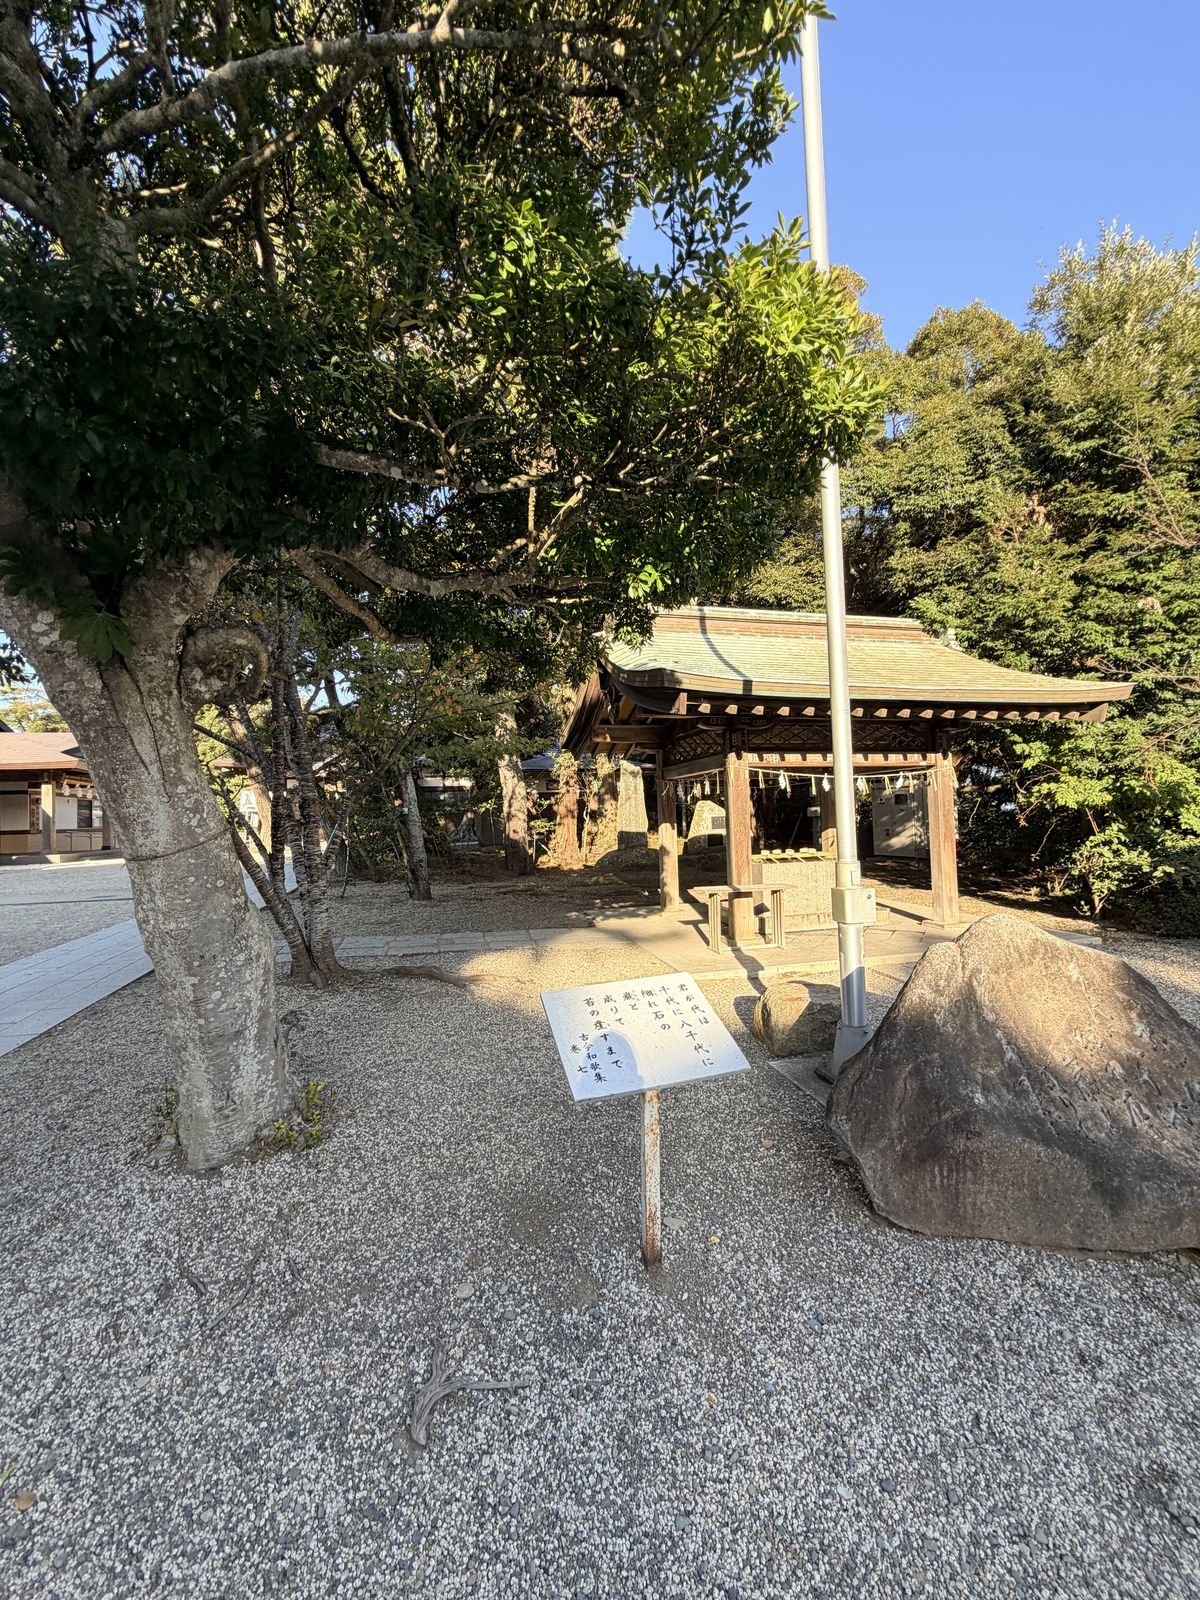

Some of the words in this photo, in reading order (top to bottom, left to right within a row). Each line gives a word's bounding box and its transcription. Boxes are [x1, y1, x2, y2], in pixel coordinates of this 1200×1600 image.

[603, 994, 625, 1025] 成りて
[641, 988, 671, 1030] 細れ石の
[677, 984, 711, 1025] 君が代は
[659, 986, 715, 1067] 千代に八千代に
[579, 1033, 607, 1083] 古今和歌集
